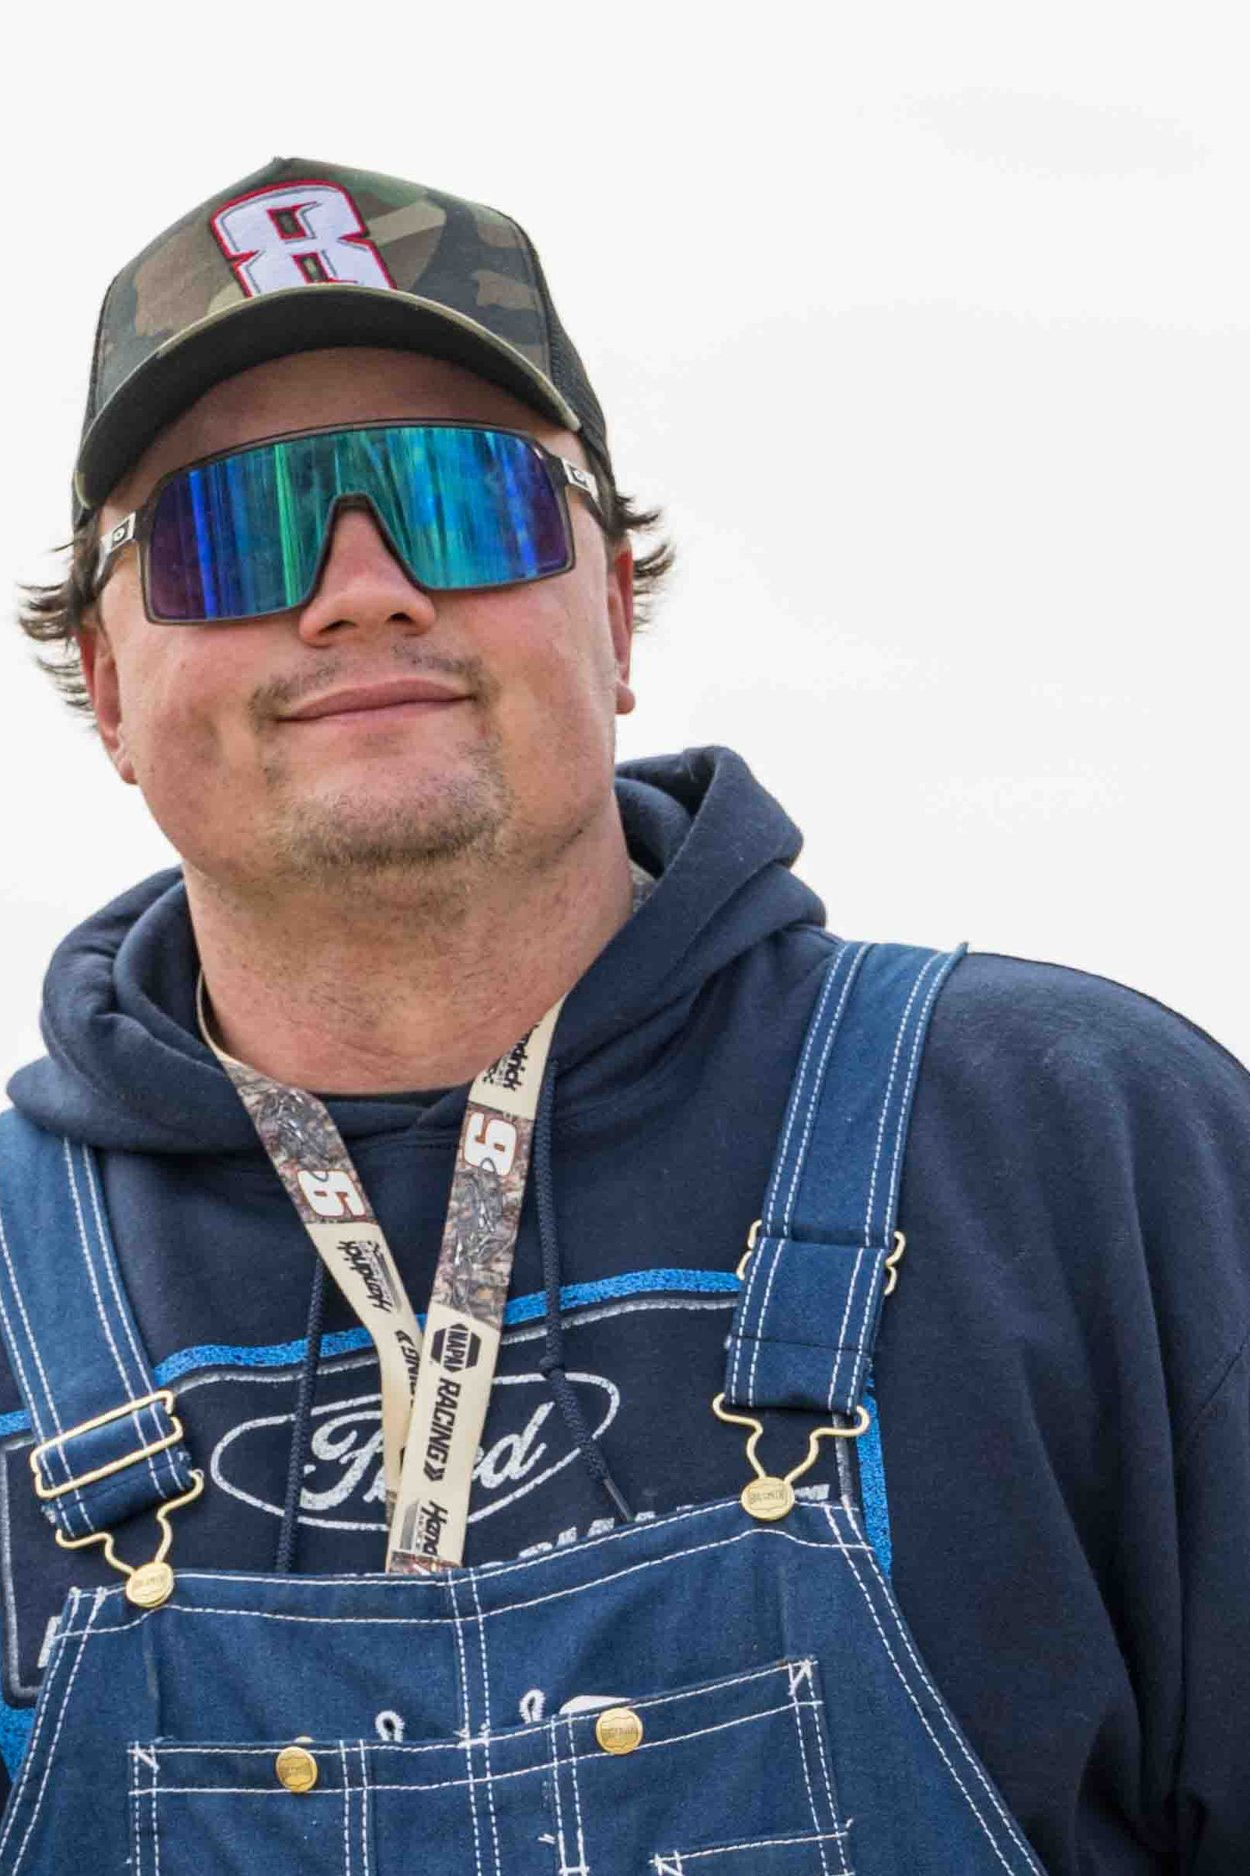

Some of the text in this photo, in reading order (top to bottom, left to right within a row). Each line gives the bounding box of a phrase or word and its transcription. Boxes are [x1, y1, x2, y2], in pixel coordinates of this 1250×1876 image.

[211, 180, 396, 297] 8
[426, 1328, 469, 1463] NAPA RACING
[300, 1401, 555, 1511] Fd
